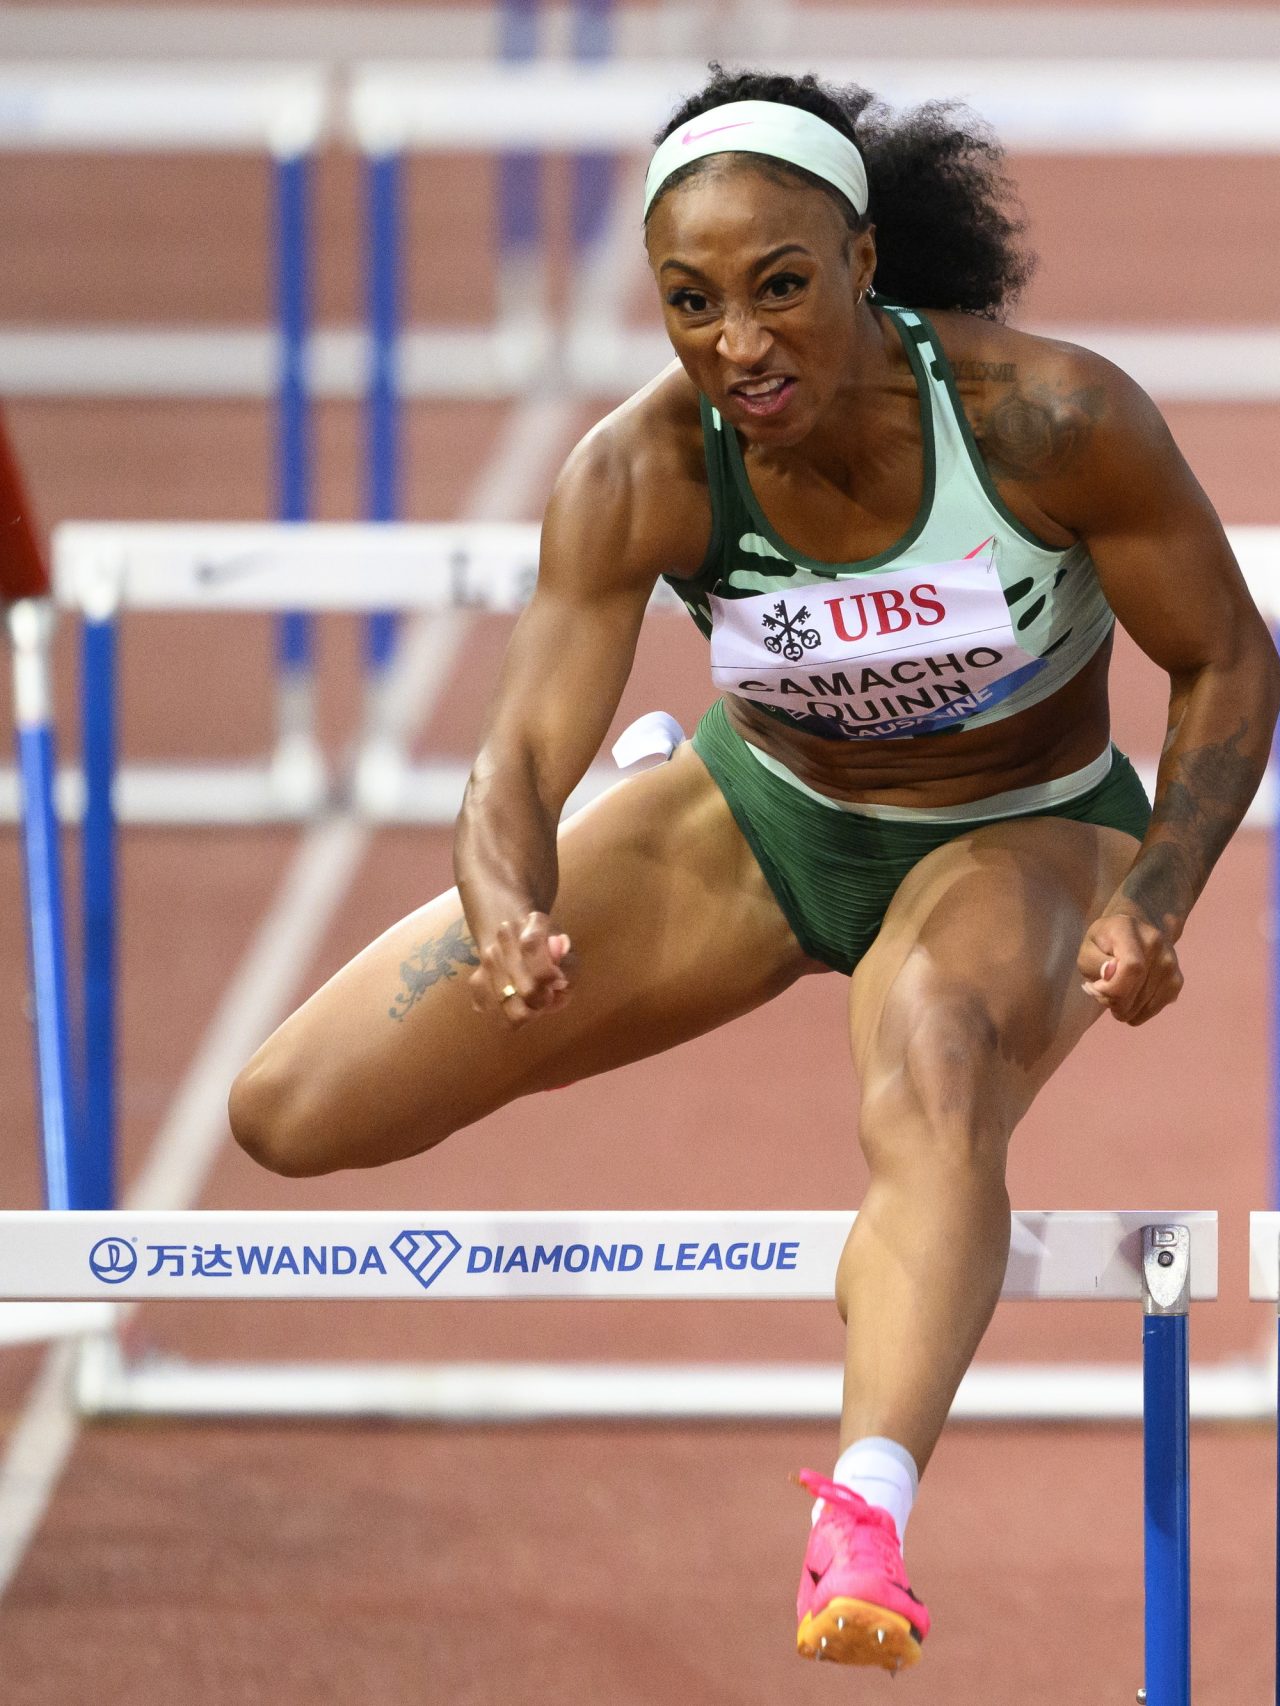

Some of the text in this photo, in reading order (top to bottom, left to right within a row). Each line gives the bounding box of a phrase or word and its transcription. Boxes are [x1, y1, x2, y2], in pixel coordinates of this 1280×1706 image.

[823, 584, 947, 643] UBS
[737, 646, 1004, 698] CAMACHO
[806, 679, 973, 724] QUINN
[839, 688, 993, 737] LAUSNE
[147, 1243, 232, 1277] 万达
[236, 1241, 800, 1275] WANDA DIAMOND LEAGUE
